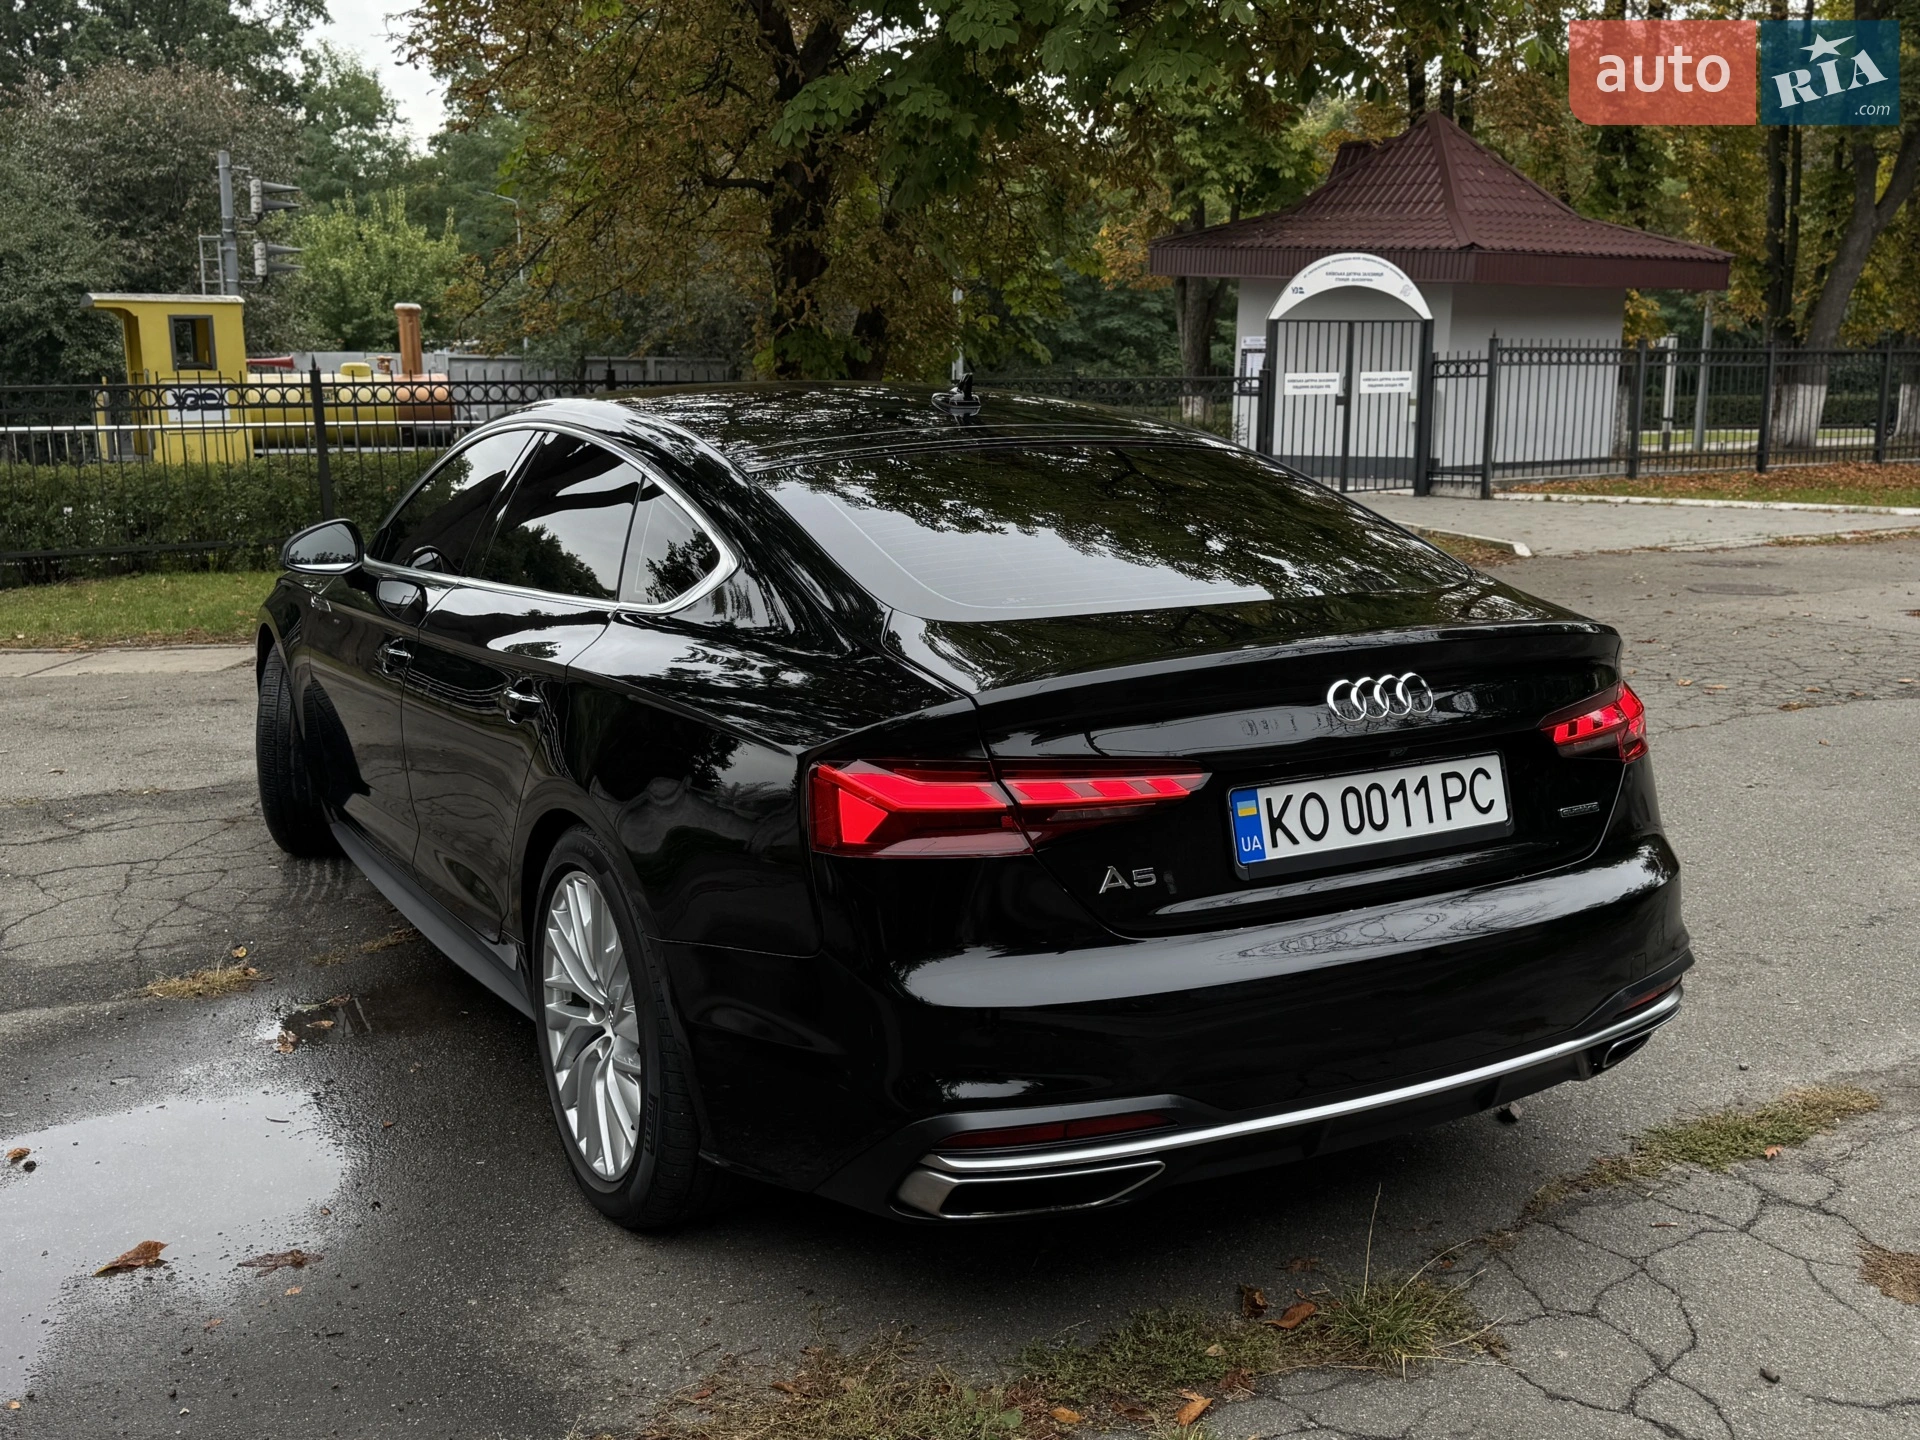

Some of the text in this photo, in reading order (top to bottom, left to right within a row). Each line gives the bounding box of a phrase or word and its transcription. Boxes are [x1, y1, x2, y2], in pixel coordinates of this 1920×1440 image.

[1265, 766, 1495, 849] KO 0011 PC
[1241, 835, 1263, 853] UA
[1098, 865, 1157, 895] A5
